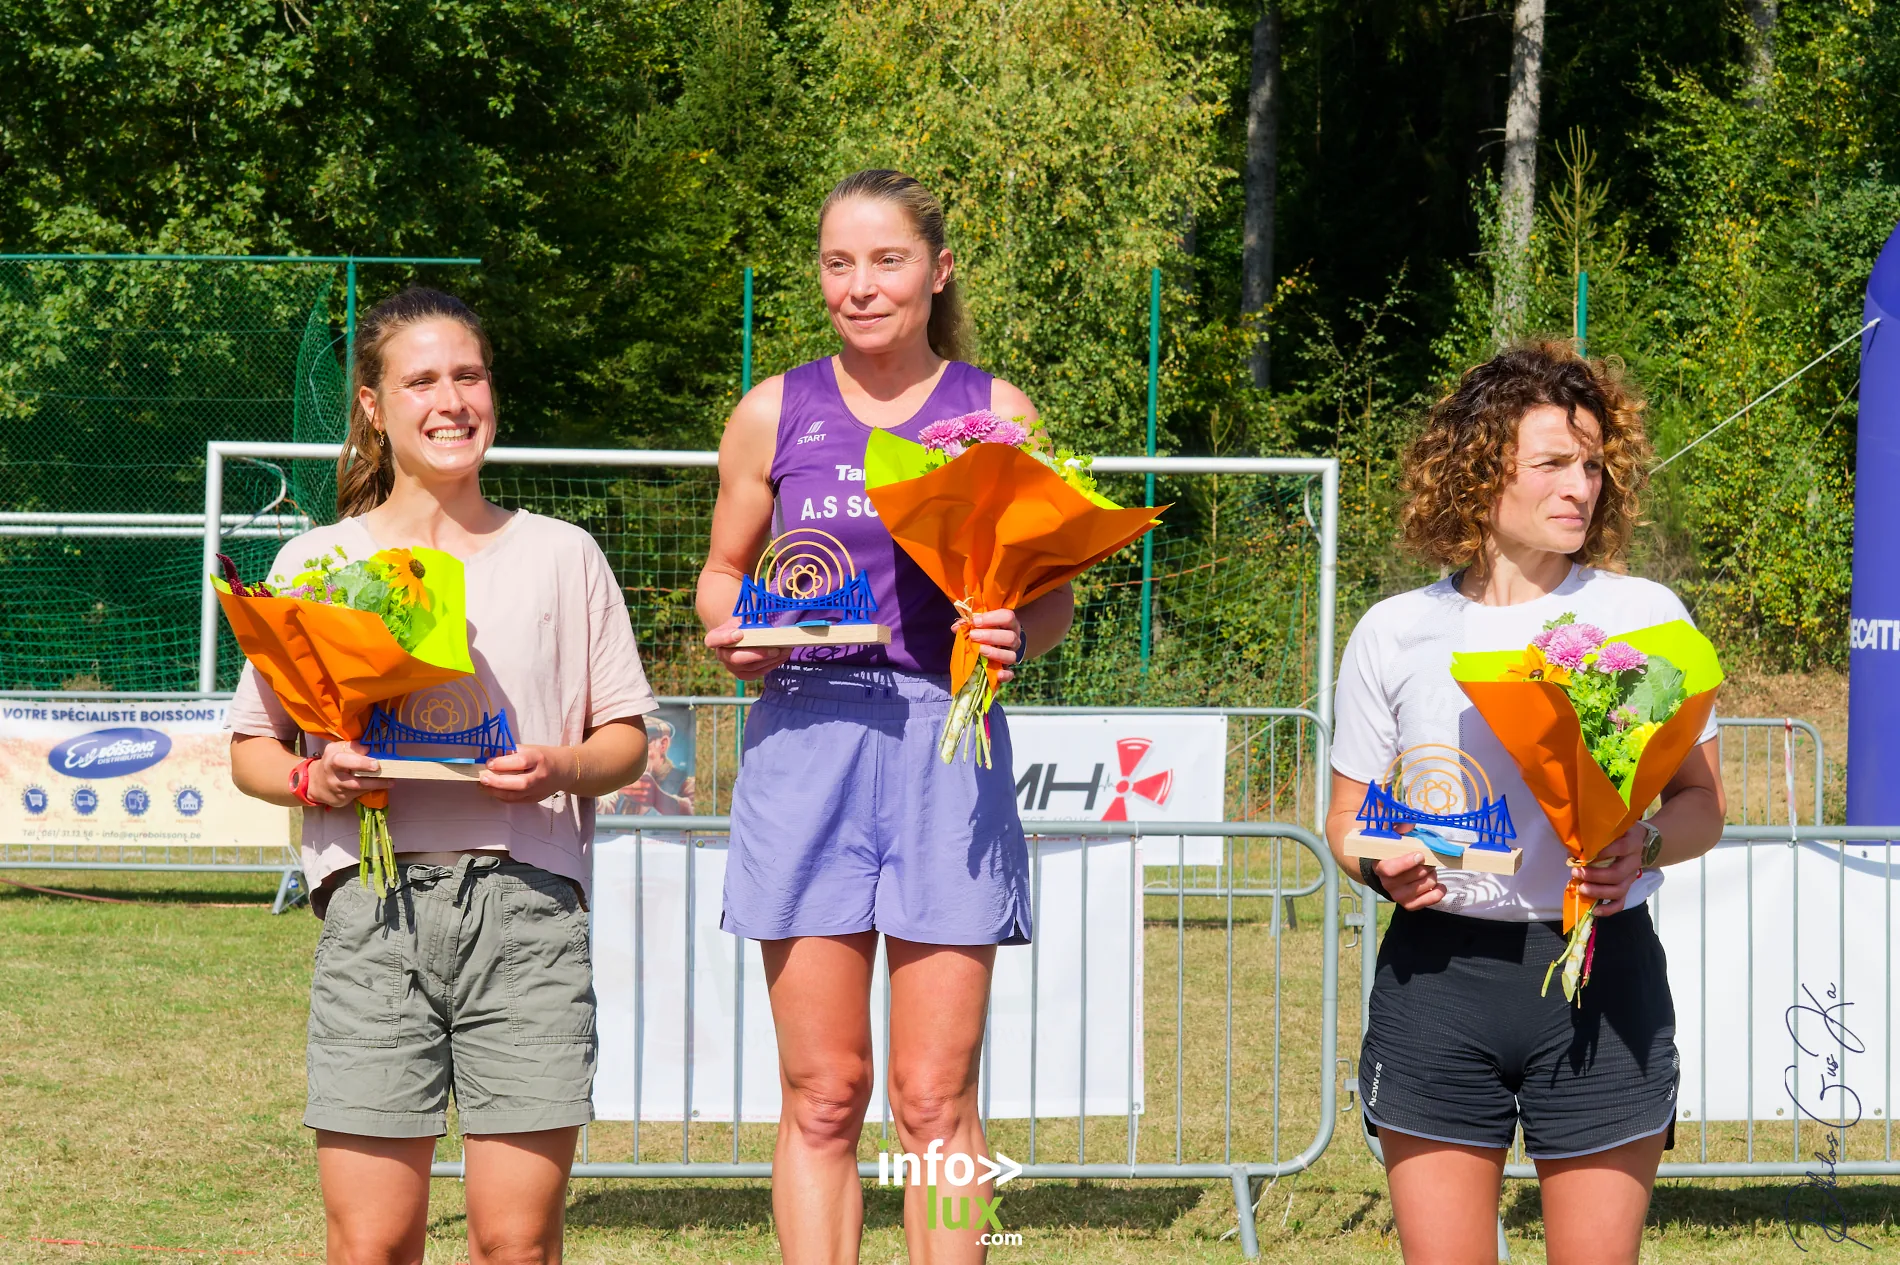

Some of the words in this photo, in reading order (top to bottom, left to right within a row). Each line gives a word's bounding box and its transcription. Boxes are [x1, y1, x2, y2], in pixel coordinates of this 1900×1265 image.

[797, 433, 827, 445] START
[801, 496, 838, 521] A.S
[3, 707, 48, 720] VOTRE
[51, 707, 137, 722] SPÉCIALISTE
[140, 709, 215, 722] BOISSONS
[97, 751, 154, 765] DISTRIBUTION
